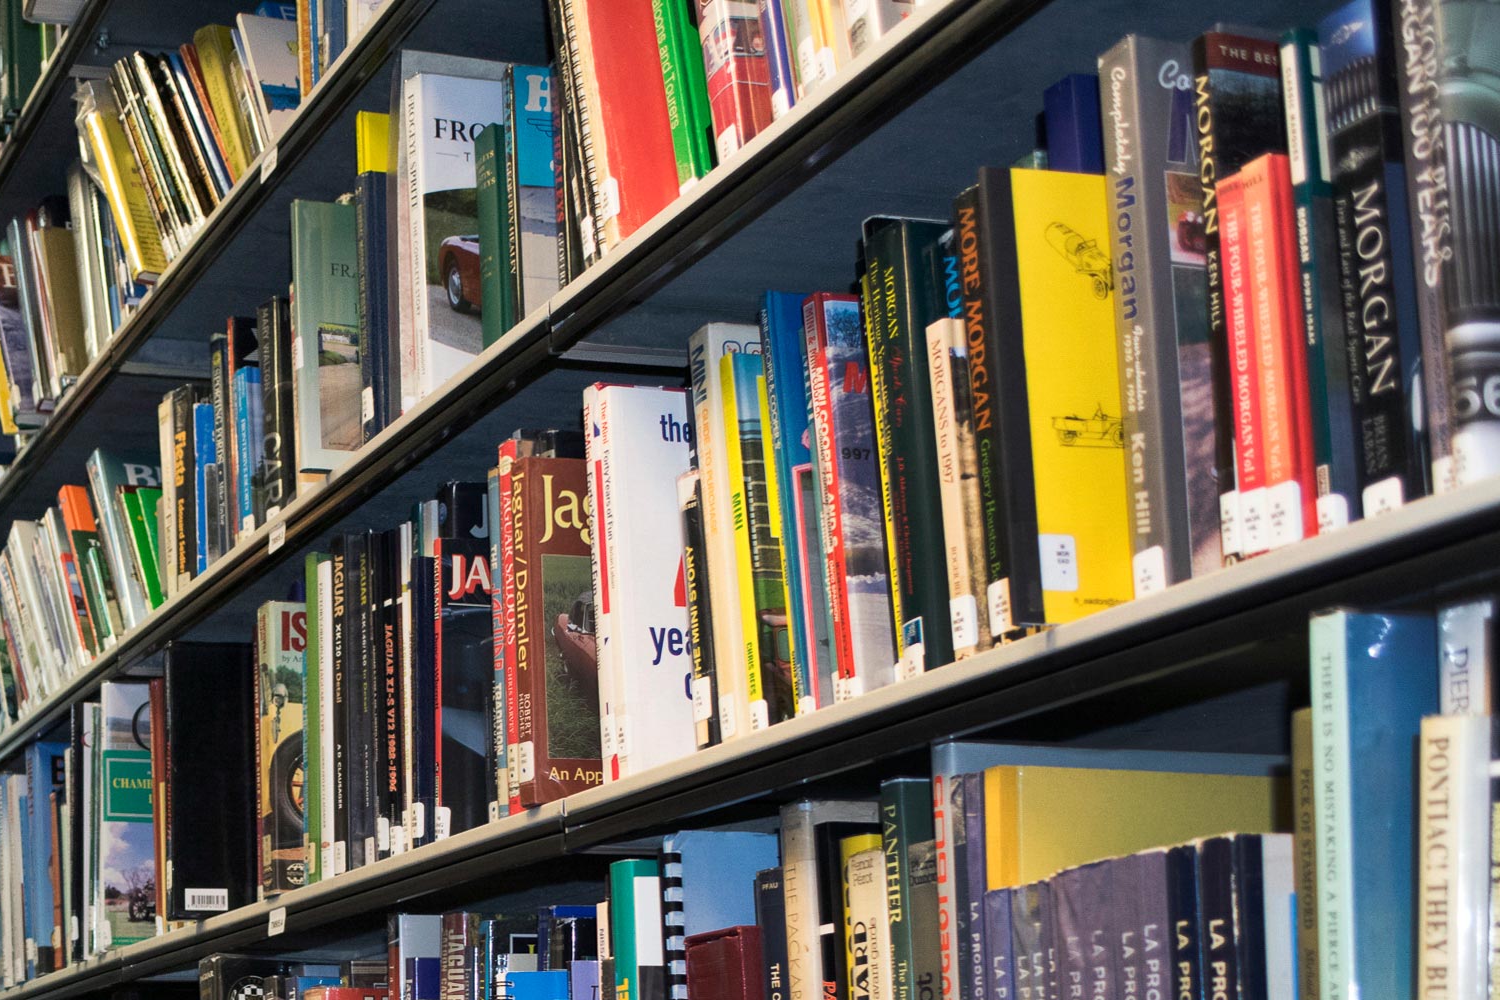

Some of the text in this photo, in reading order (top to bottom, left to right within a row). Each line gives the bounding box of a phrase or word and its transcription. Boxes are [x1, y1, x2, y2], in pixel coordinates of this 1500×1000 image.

[660, 46, 678, 130] and Tourers
[407, 94, 418, 210] FROGEYE SPRITE
[1109, 66, 1139, 321] Completely Morgan
[1195, 76, 1223, 331] MORGAN KEN HILL
[1251, 202, 1264, 235] THE
[882, 266, 900, 338] MORGAN
[958, 208, 991, 431] MORE MORGAN
[1253, 238, 1275, 366] FOUR-WHEELED
[1352, 180, 1396, 396] MORGAN
[930, 339, 954, 484] MORGANS to 1997
[1261, 370, 1279, 442] MORGAN
[701, 408, 718, 534] GUIDE TO PURCHASE
[1130, 433, 1151, 534] Ken Hill
[1269, 446, 1280, 468] Vol
[173, 432, 188, 574] Fiesta Edouard Seidler
[732, 493, 743, 531] MINI
[332, 555, 345, 704] JAGUAR XK120 In Detail
[523, 693, 533, 734] ROBERT
[1423, 736, 1450, 870] PONTIAC!
[761, 881, 779, 891] PFAU
[883, 804, 902, 925] PANTHER
[970, 902, 980, 921] LA
[1144, 925, 1158, 952] LA
[1176, 921, 1189, 950] LA
[1208, 919, 1224, 950] LA
[1424, 878, 1448, 956] THEY
[769, 962, 781, 988] THE
